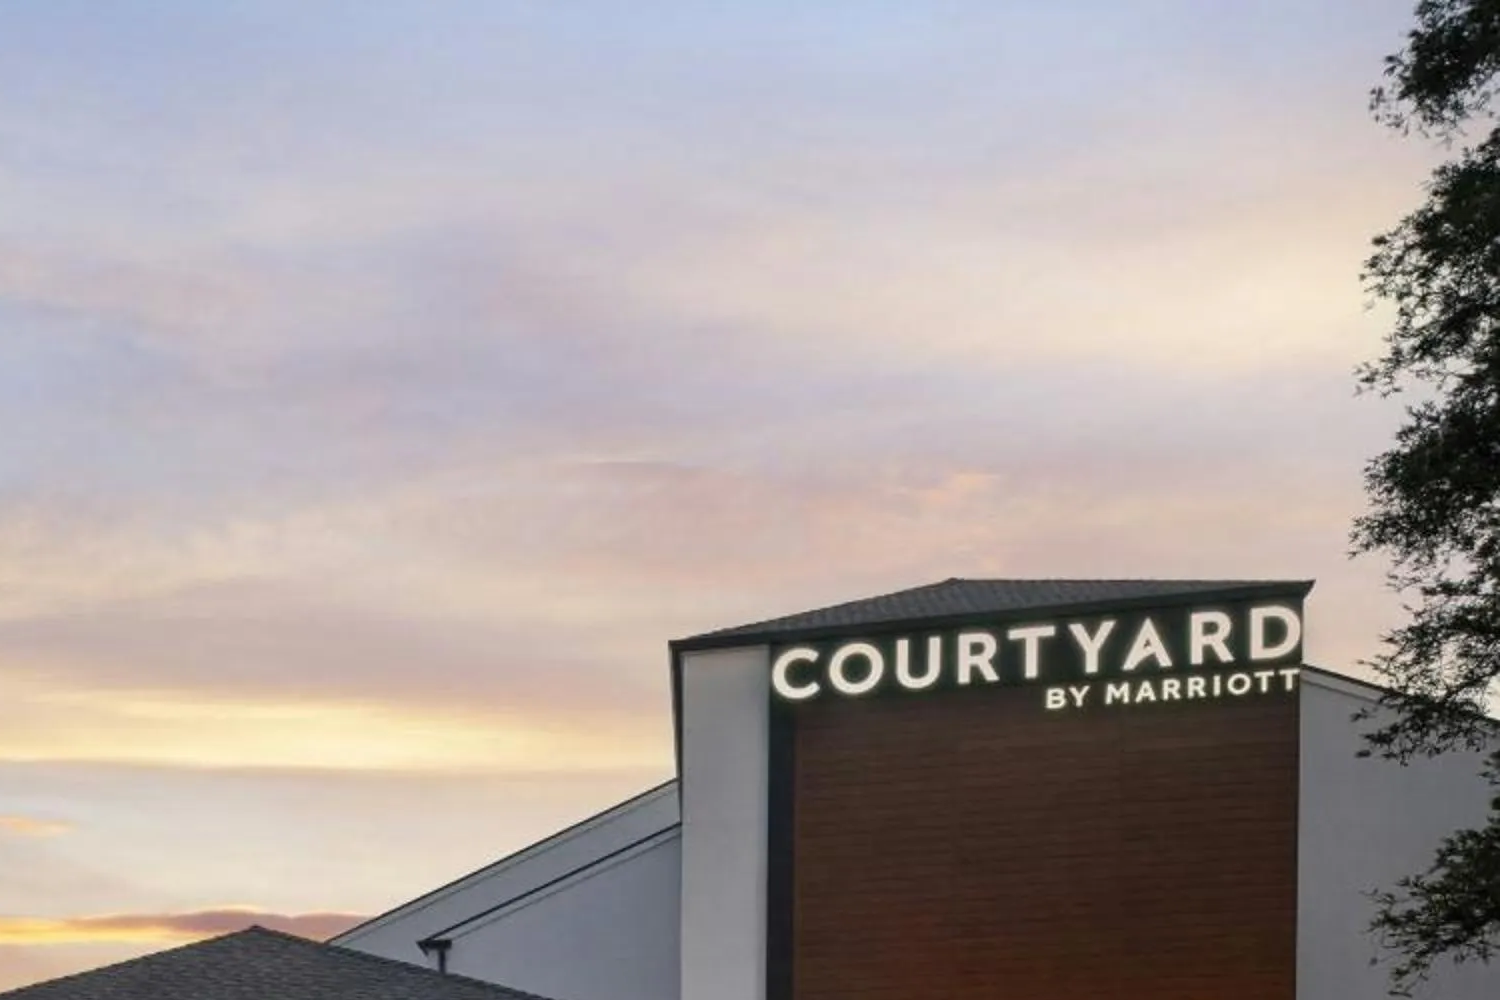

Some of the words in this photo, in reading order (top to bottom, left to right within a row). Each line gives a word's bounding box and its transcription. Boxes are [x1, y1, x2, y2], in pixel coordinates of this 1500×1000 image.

[771, 605, 1301, 699] COURTYARD
[1046, 685, 1090, 709] BY
[1106, 669, 1299, 705] MARRIOTT
